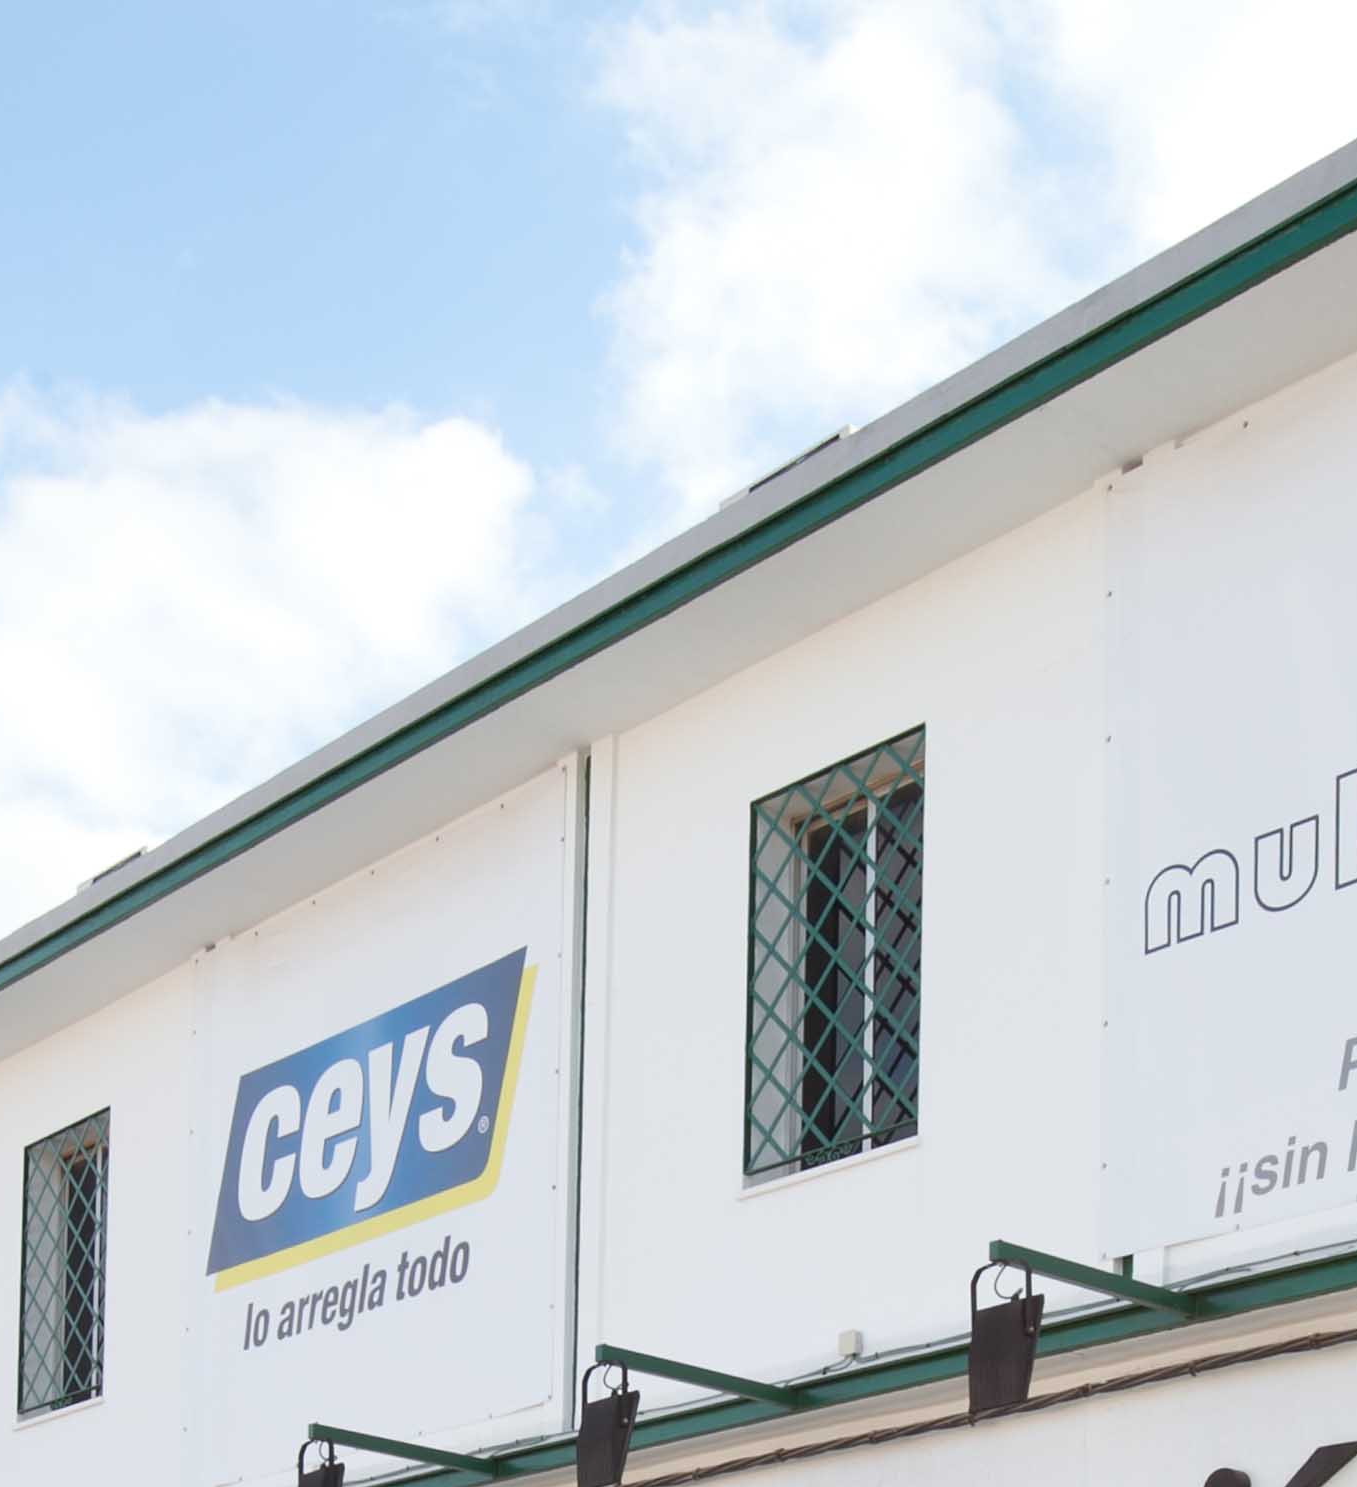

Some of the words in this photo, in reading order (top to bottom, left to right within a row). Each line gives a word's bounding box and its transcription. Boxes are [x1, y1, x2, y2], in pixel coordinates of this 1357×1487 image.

[238, 1002, 489, 1222] ceys
[1214, 1132, 1329, 1218] ¡¡sin
[243, 1302, 270, 1351] lo
[276, 1263, 387, 1332] arregla
[395, 1235, 470, 1301] todo
